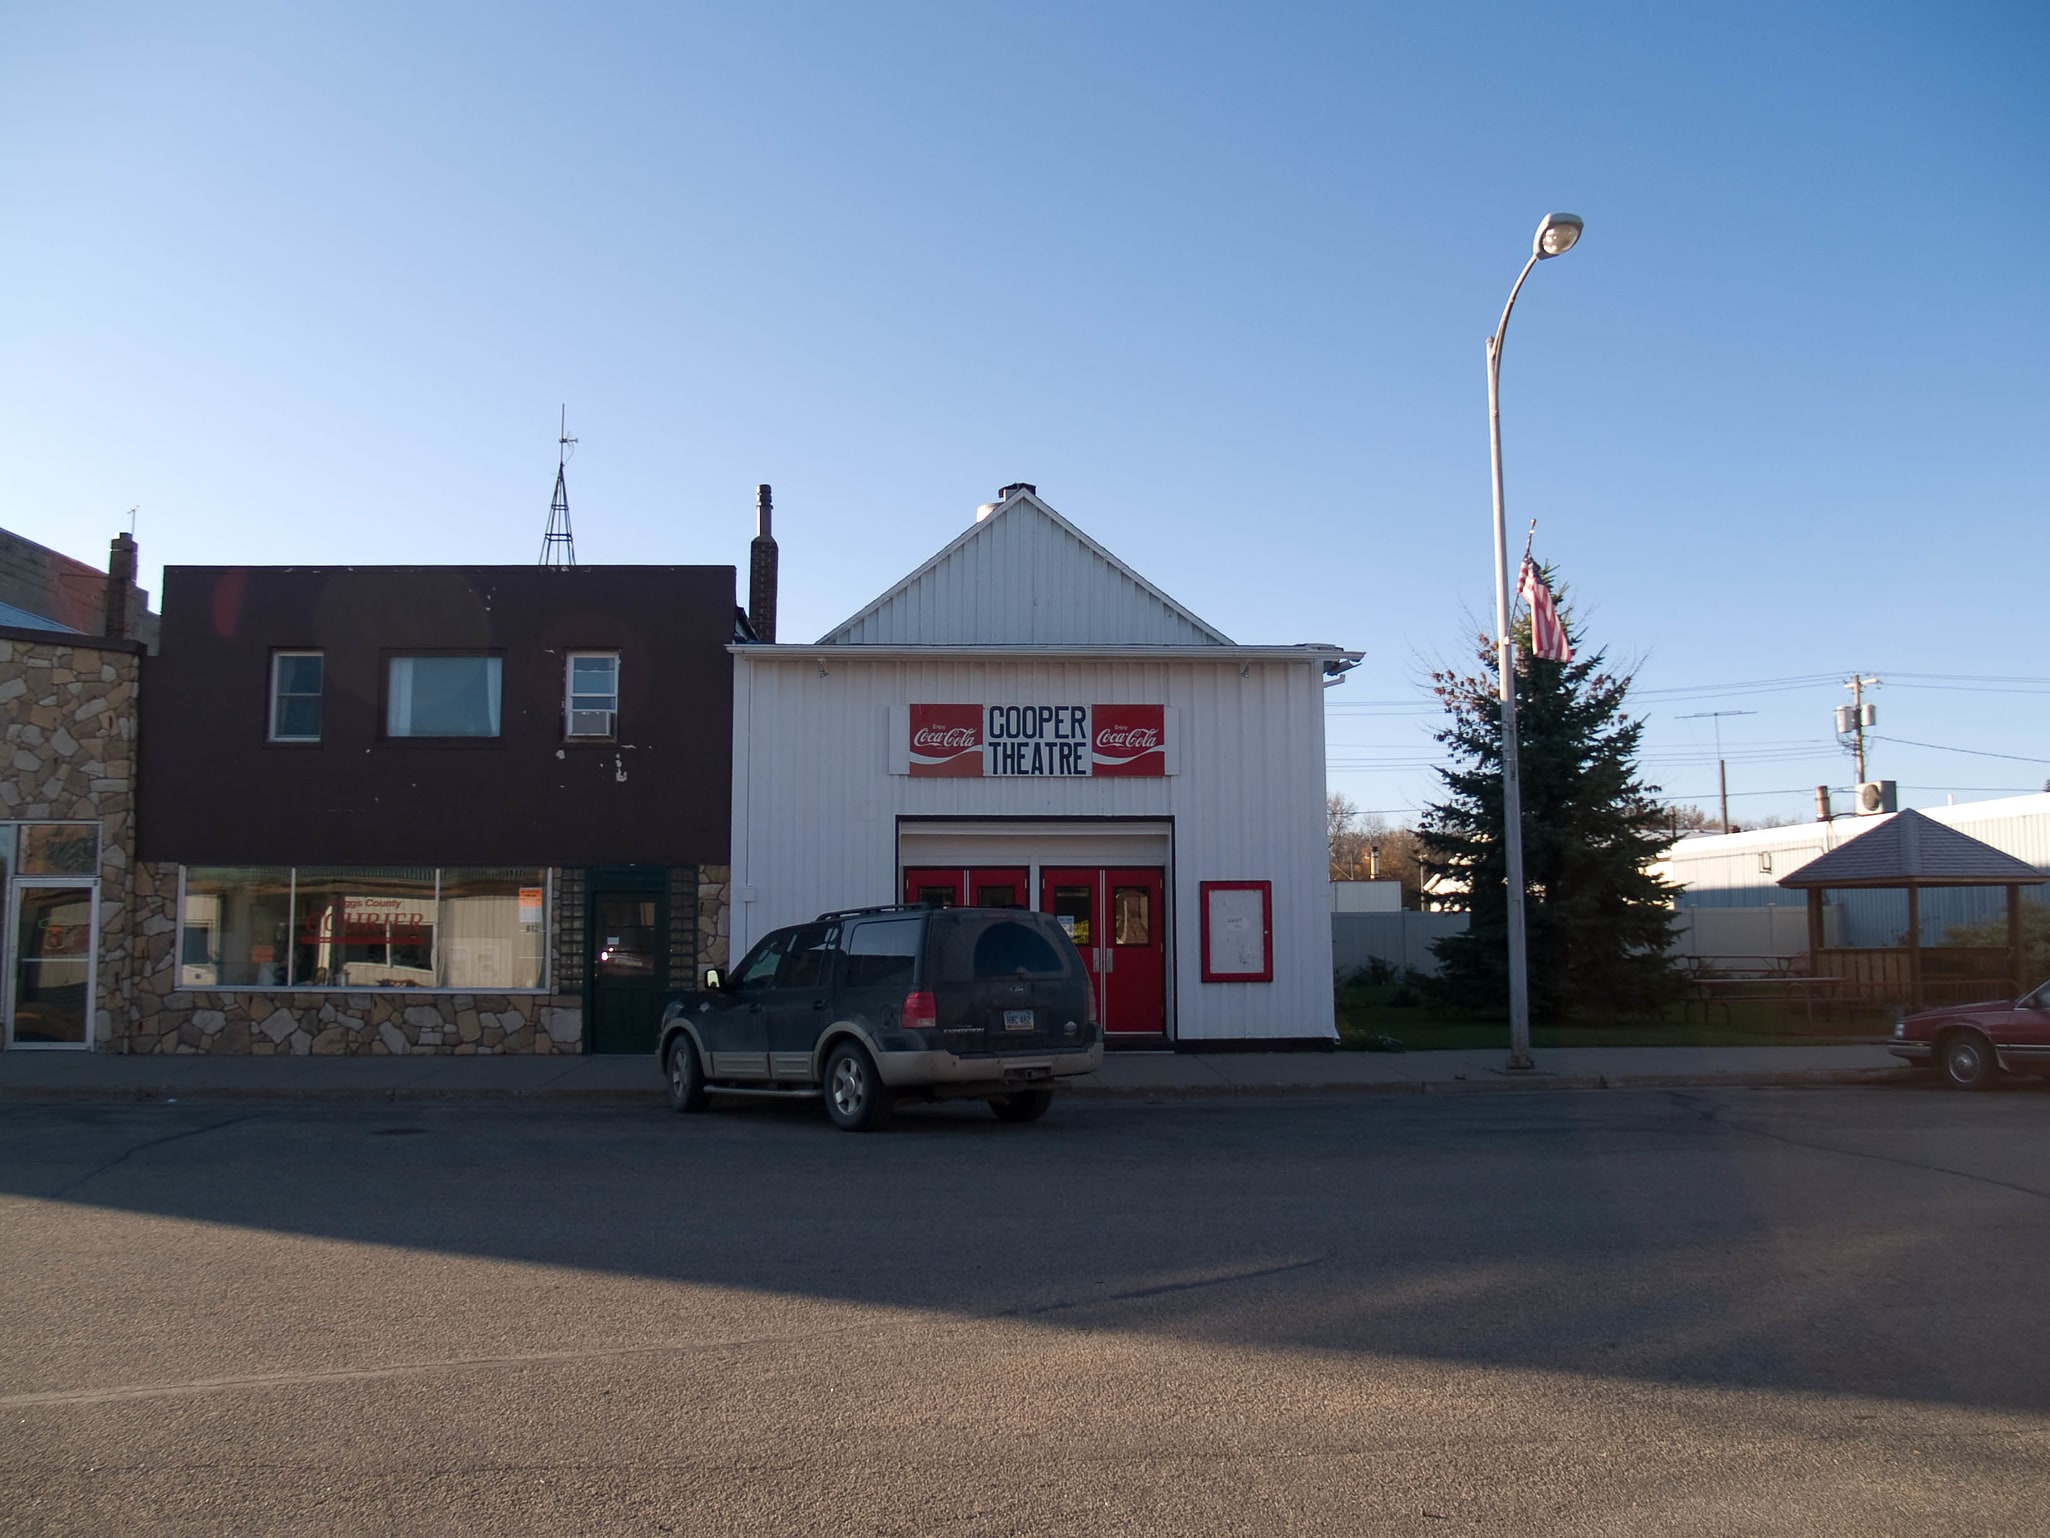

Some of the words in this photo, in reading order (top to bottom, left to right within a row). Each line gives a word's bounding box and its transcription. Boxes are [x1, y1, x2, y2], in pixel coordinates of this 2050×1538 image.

[989, 705, 1086, 739] COOPER
[914, 727, 976, 747] Coca-Cola
[1096, 728, 1159, 748] Coca-Cola
[988, 742, 1086, 775] THEATRE
[365, 899, 401, 909] County
[306, 912, 423, 932] COURIER
